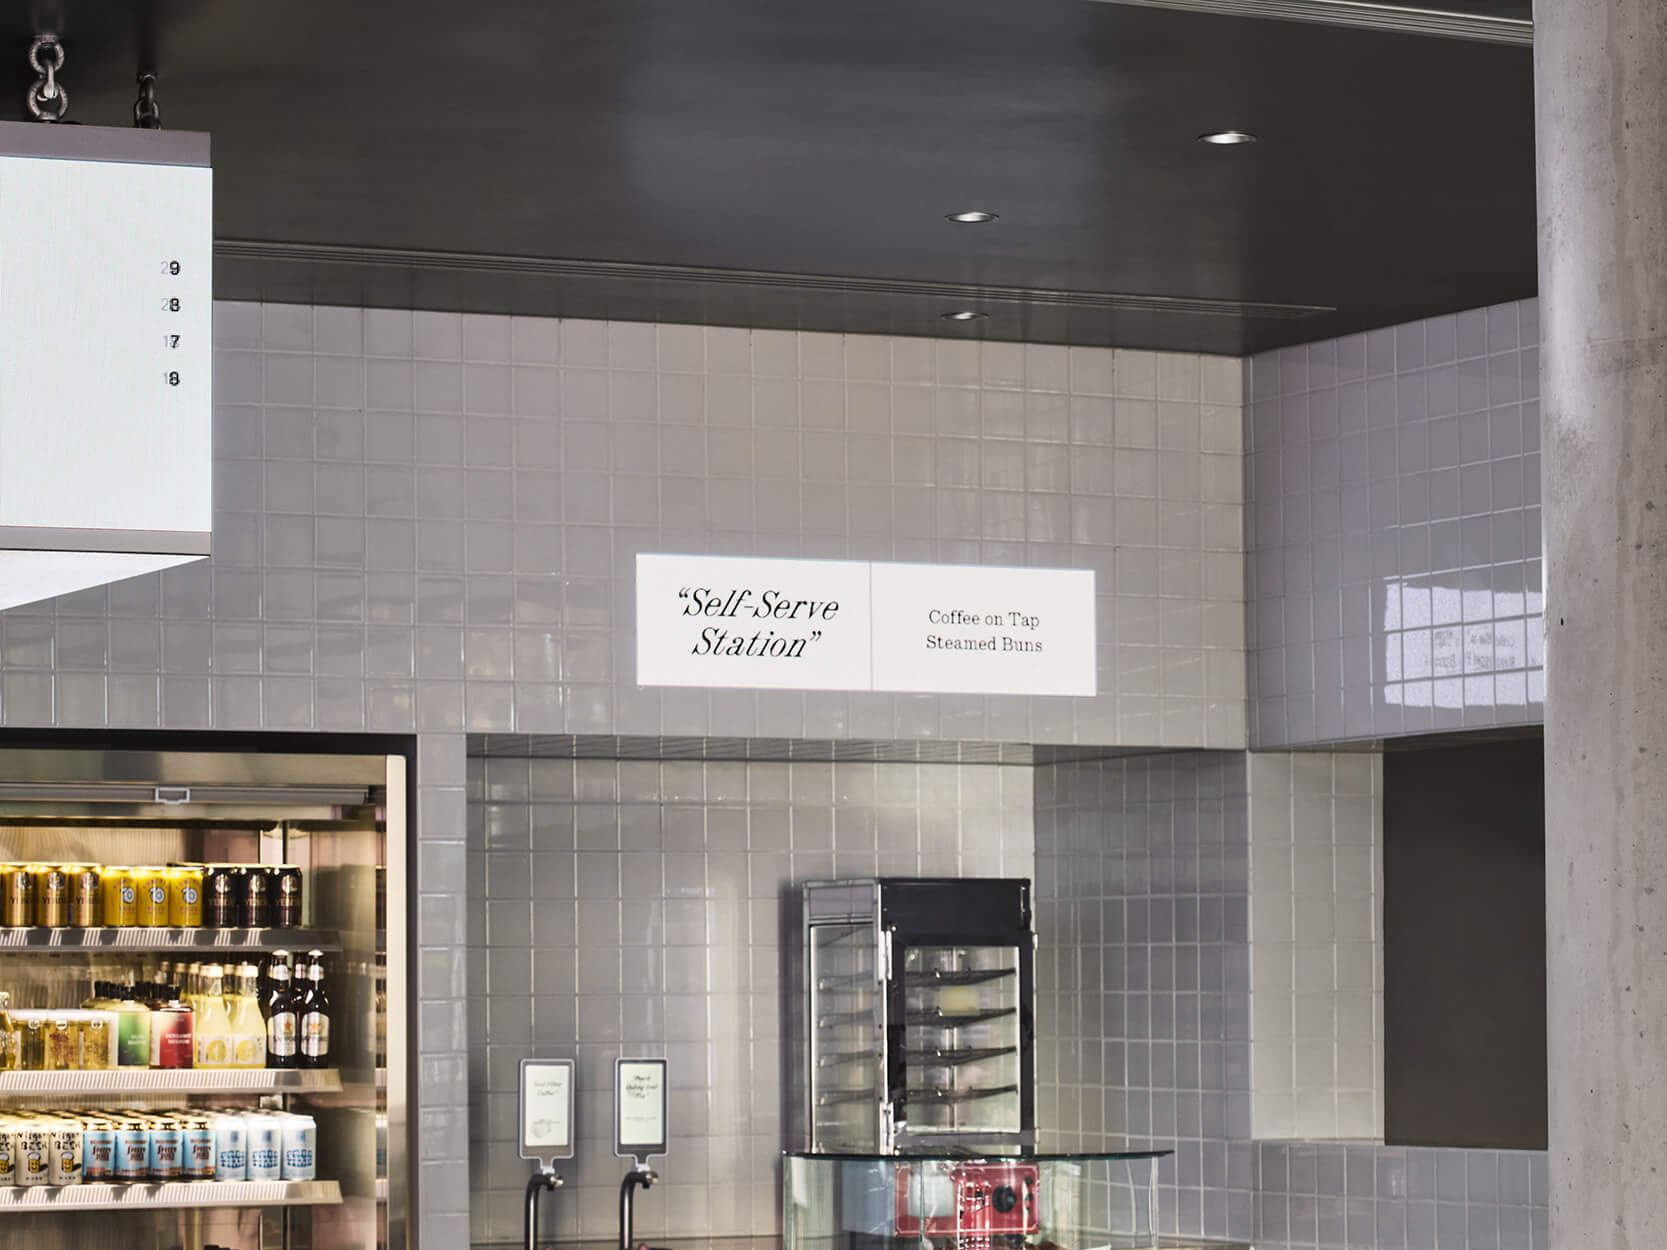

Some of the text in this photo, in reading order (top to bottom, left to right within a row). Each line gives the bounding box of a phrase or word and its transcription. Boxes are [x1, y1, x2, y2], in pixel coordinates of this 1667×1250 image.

[928, 608, 1041, 630] Coffee on Tap
[926, 634, 1043, 652] Steamed Buns
